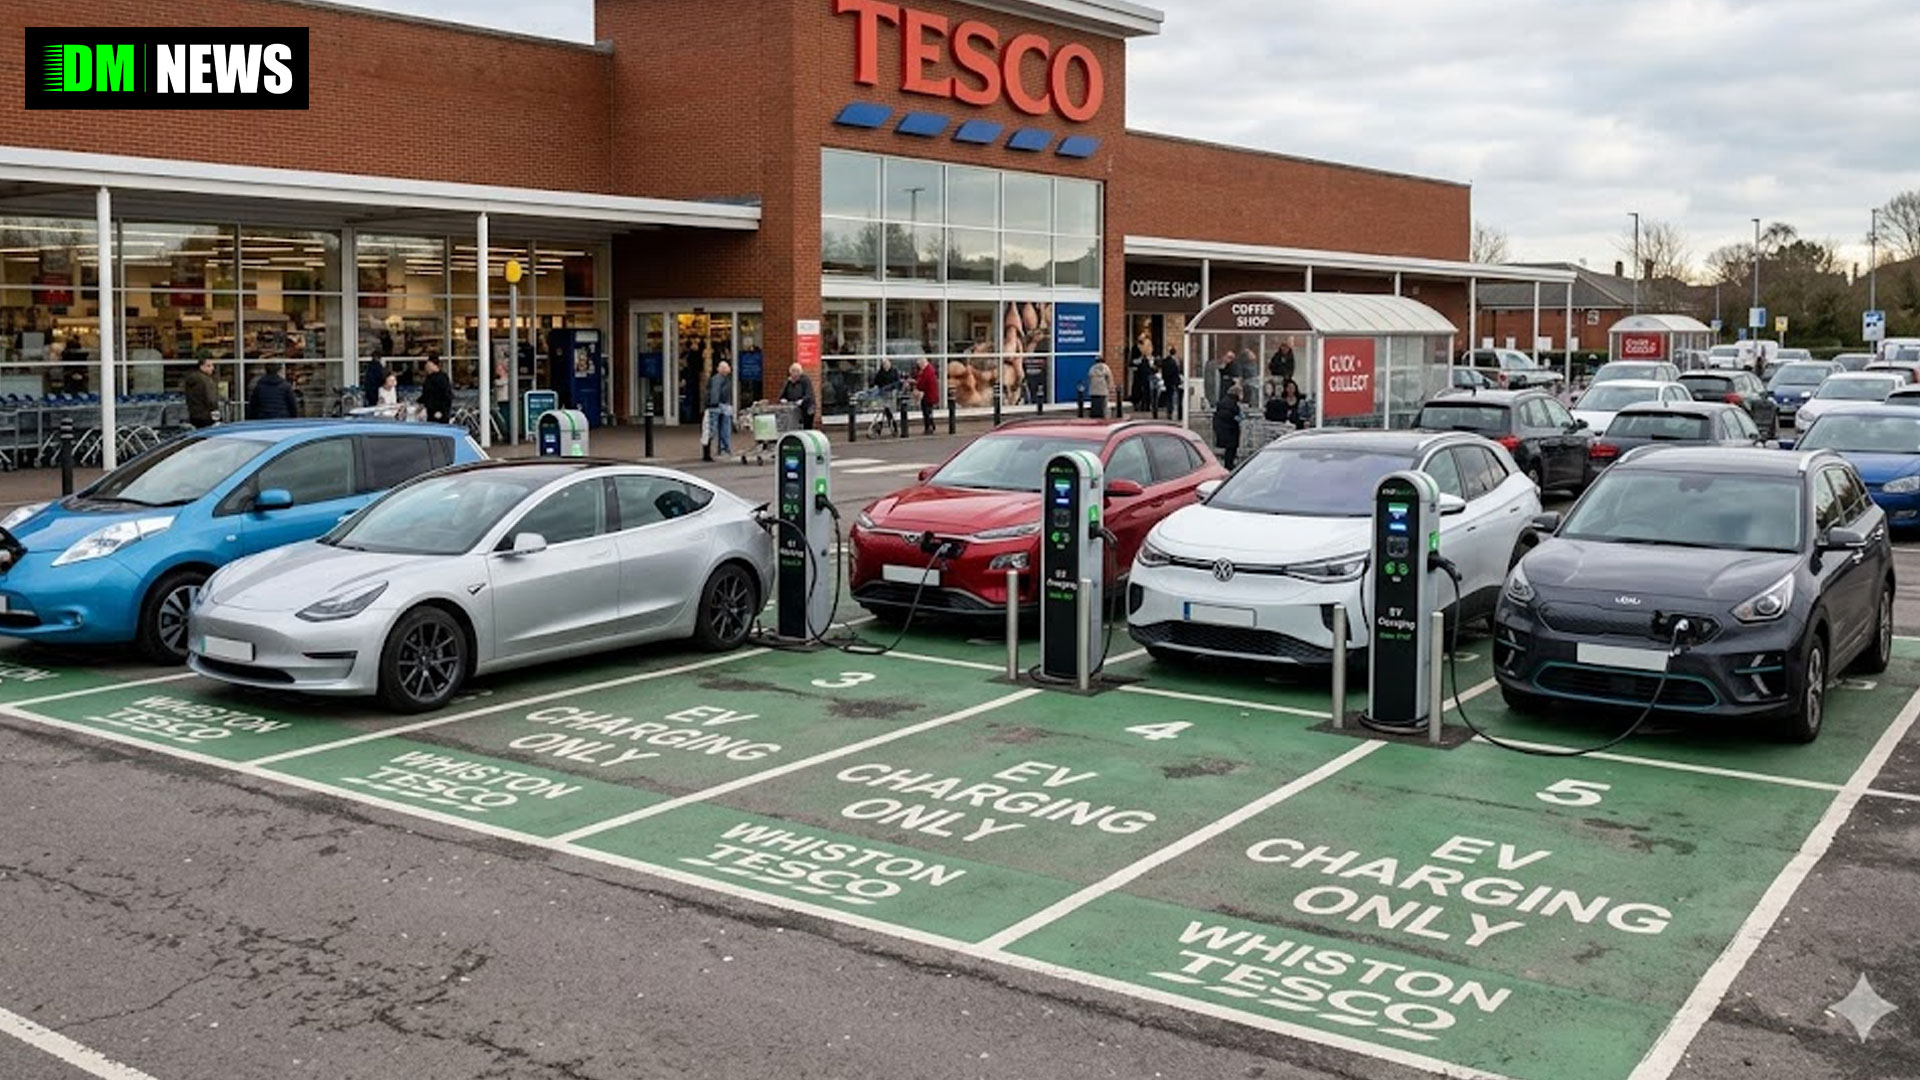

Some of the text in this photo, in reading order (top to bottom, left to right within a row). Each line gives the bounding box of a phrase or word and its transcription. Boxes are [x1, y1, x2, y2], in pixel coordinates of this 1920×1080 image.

[835, 0, 1104, 122] TESCO
[1130, 280, 1200, 298] COFFEE SHOP
[1232, 304, 1275, 327] COFFEE SHOP
[811, 671, 876, 688] 3
[107, 707, 233, 739] TESCO
[132, 695, 292, 734] WHISTON
[526, 706, 782, 761] CHARGING
[664, 705, 759, 727] EV
[1124, 721, 1193, 741] 4
[508, 733, 661, 767] ONLY
[366, 766, 519, 807] TESCO
[390, 751, 582, 799] WHISTON
[993, 760, 1099, 788] EV
[1535, 778, 1611, 806] 5
[836, 763, 1157, 834] CHARGING
[841, 798, 1026, 842] ONLY
[706, 842, 902, 898] TESCO
[720, 822, 967, 887] WHISTON
[1430, 835, 1552, 871] EV
[1245, 838, 1672, 934] CHARGING
[1292, 885, 1526, 947] ONLY
[1177, 920, 1513, 1013] WHISTON
[1179, 949, 1456, 1031] TESCO
